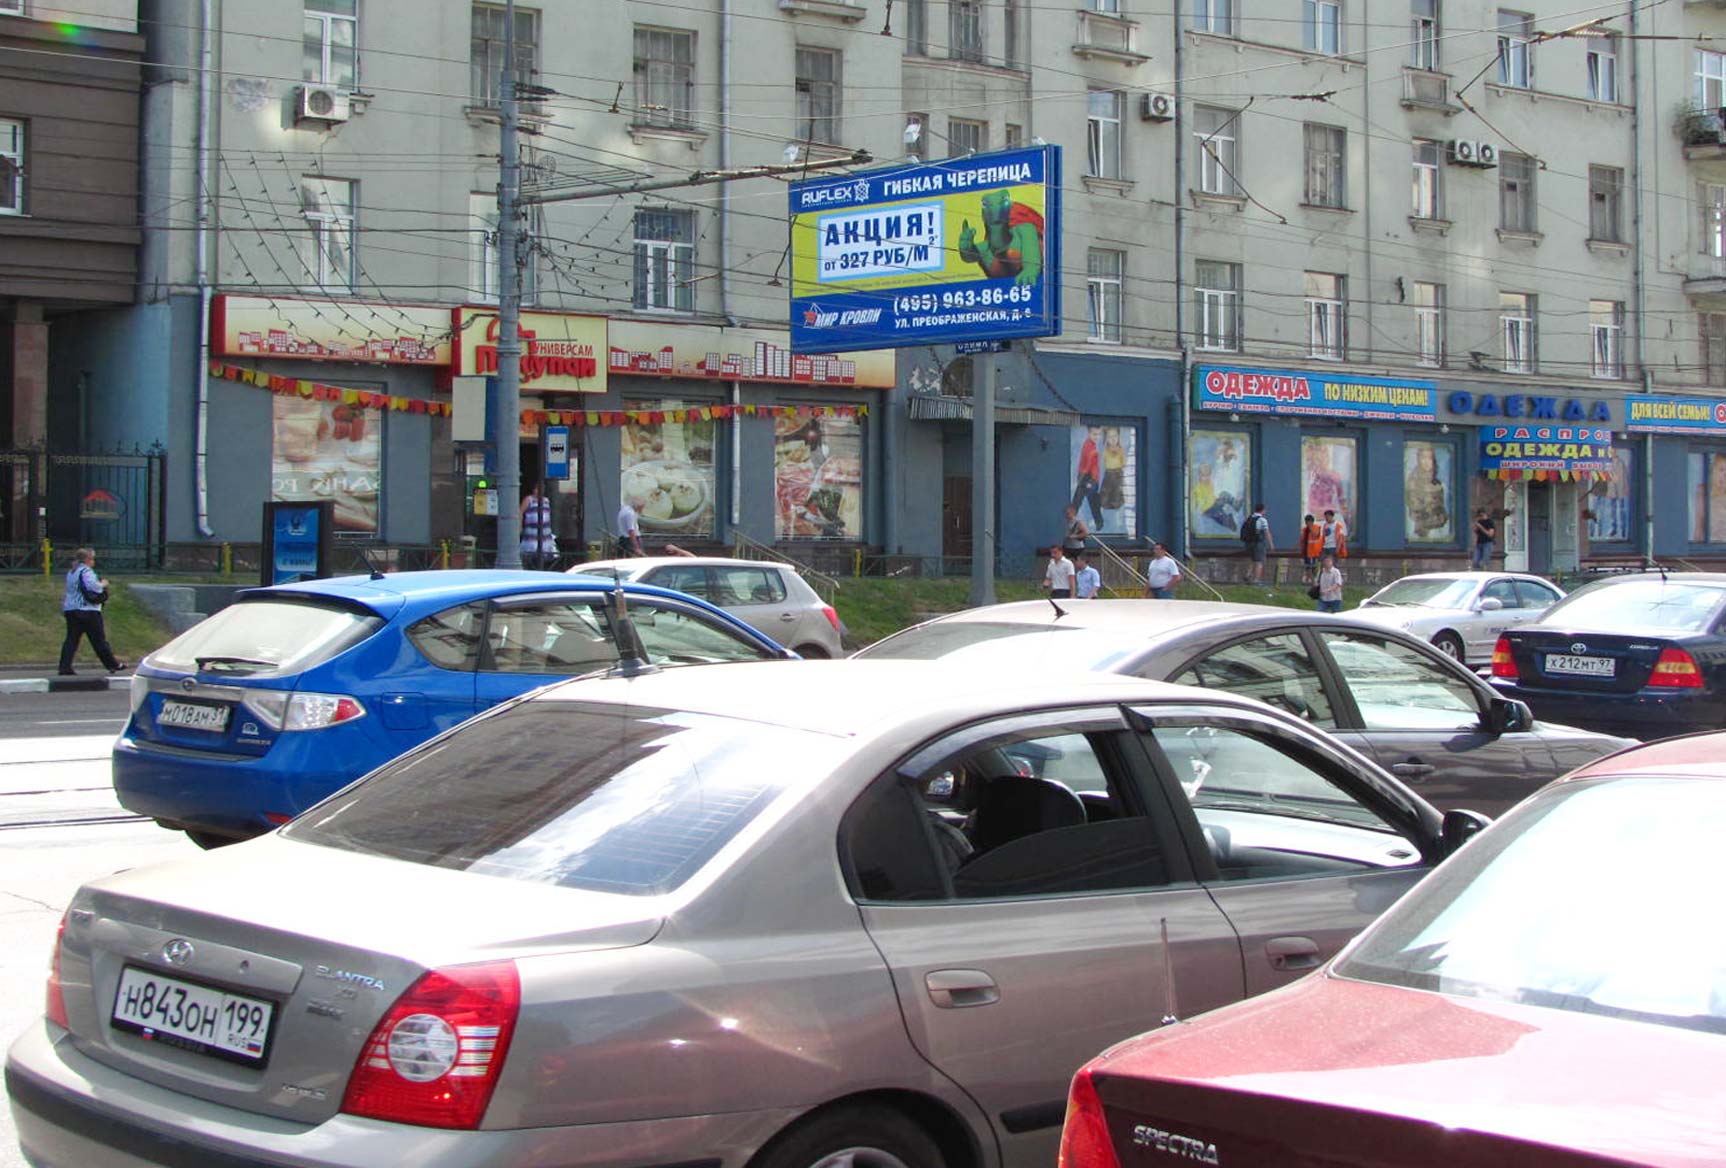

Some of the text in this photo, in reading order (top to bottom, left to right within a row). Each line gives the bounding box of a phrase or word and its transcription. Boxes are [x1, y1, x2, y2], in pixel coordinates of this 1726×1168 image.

[883, 162, 1032, 196] ГИБКАЯ ЧЕРЕПИЦА
[801, 186, 852, 204] RUFLEX
[824, 211, 934, 247] АКЦИЯ!
[840, 251, 869, 270] 327
[893, 285, 1032, 316] (495) 963-86-65
[814, 308, 882, 327] МИР КРОВЛИ
[895, 318, 911, 329] УЛ.
[912, 310, 1010, 328] ПРЕОБРАЖЕНСКАЯ,
[535, 341, 594, 357] УНИВЕРСАМ
[1205, 370, 1428, 408] ОДЕЖДА ПО НИЗКИМ ЦЕНАМ!
[1449, 390, 1612, 422] ОДЕЖДА
[1631, 401, 1652, 421] ДЛЯ
[1653, 400, 1677, 419] ВСЕЙ
[1677, 403, 1710, 421] СЕМЬИ!
[1485, 442, 1593, 459] ОДЕЖДА
[1599, 658, 1611, 668] 97
[315, 964, 385, 991] ELANTRA
[124, 980, 218, 1039] Н843ОН
[225, 999, 264, 1037] 199
[227, 1032, 247, 1050] RUS
[1133, 1124, 1219, 1166] SPECTRA
